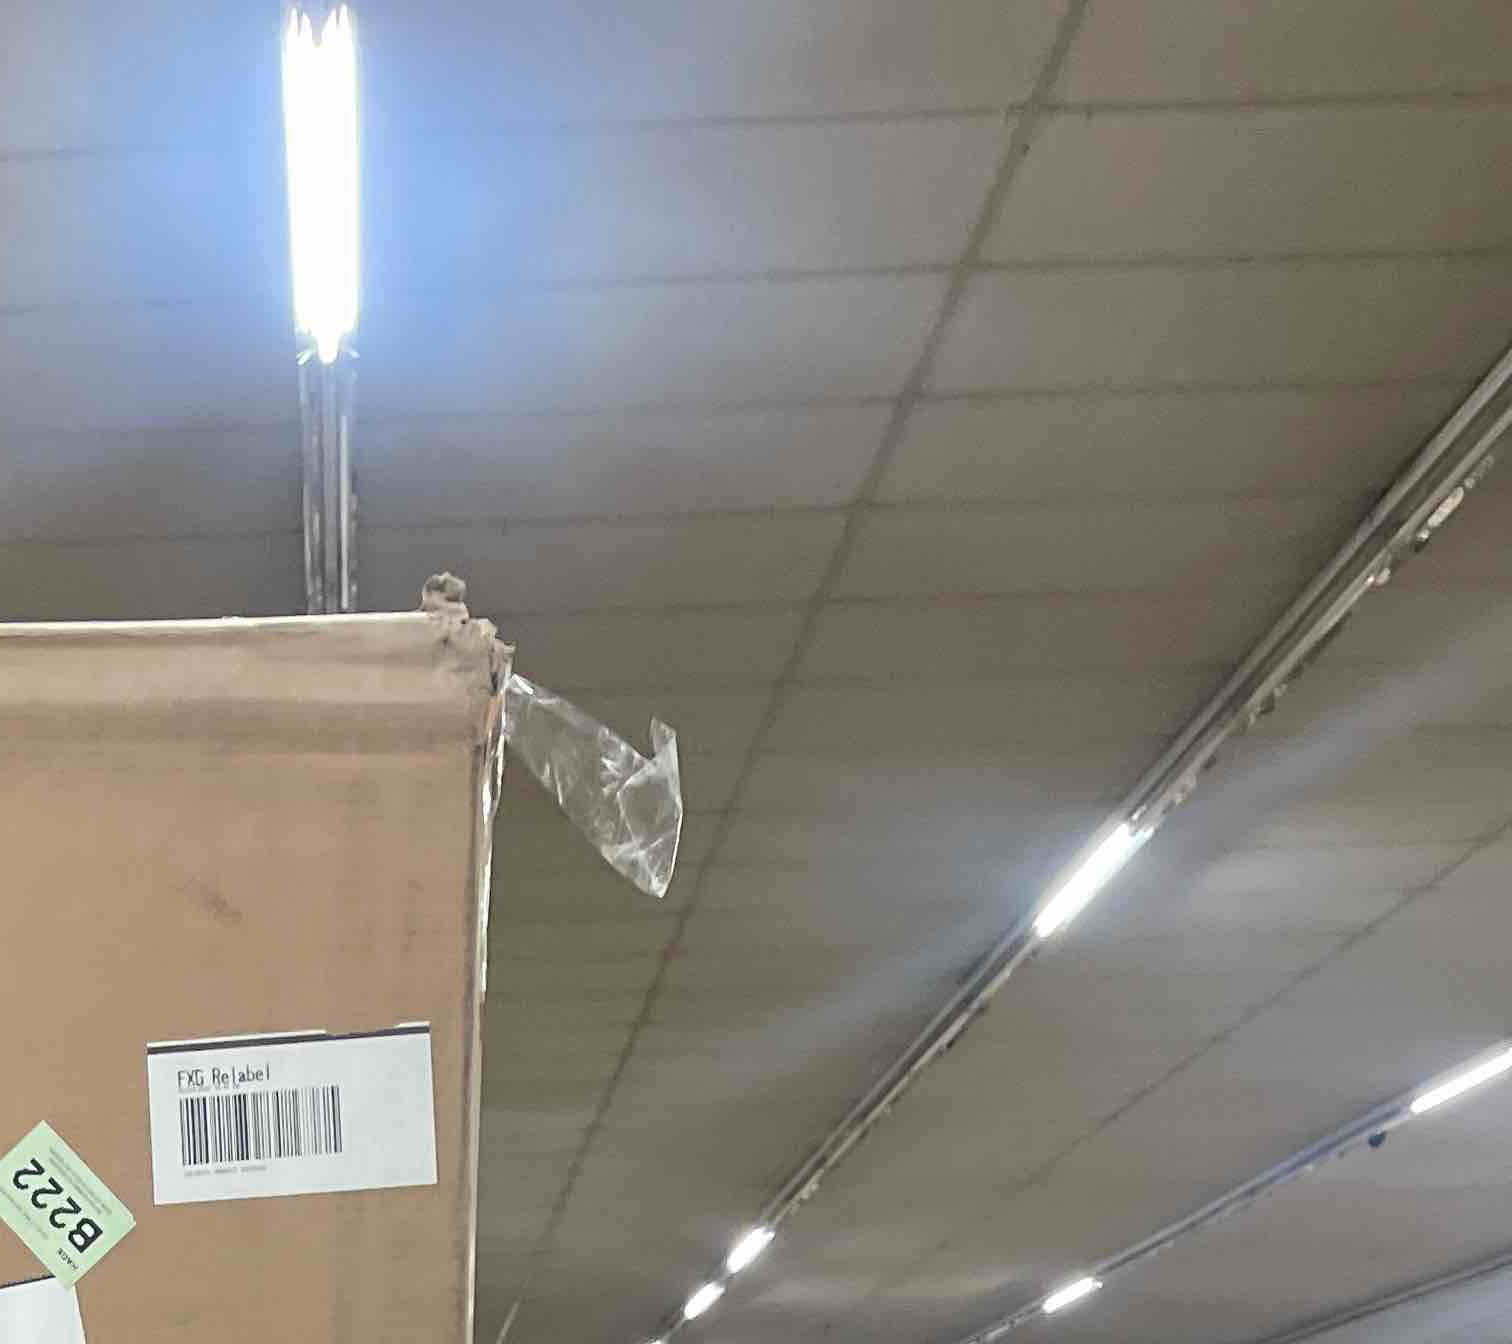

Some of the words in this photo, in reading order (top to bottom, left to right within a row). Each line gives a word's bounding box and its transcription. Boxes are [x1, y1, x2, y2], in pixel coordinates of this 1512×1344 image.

[176, 1068, 204, 1088] FXG
[211, 1063, 271, 1087] Relabel
[12, 1157, 103, 1254] B222
